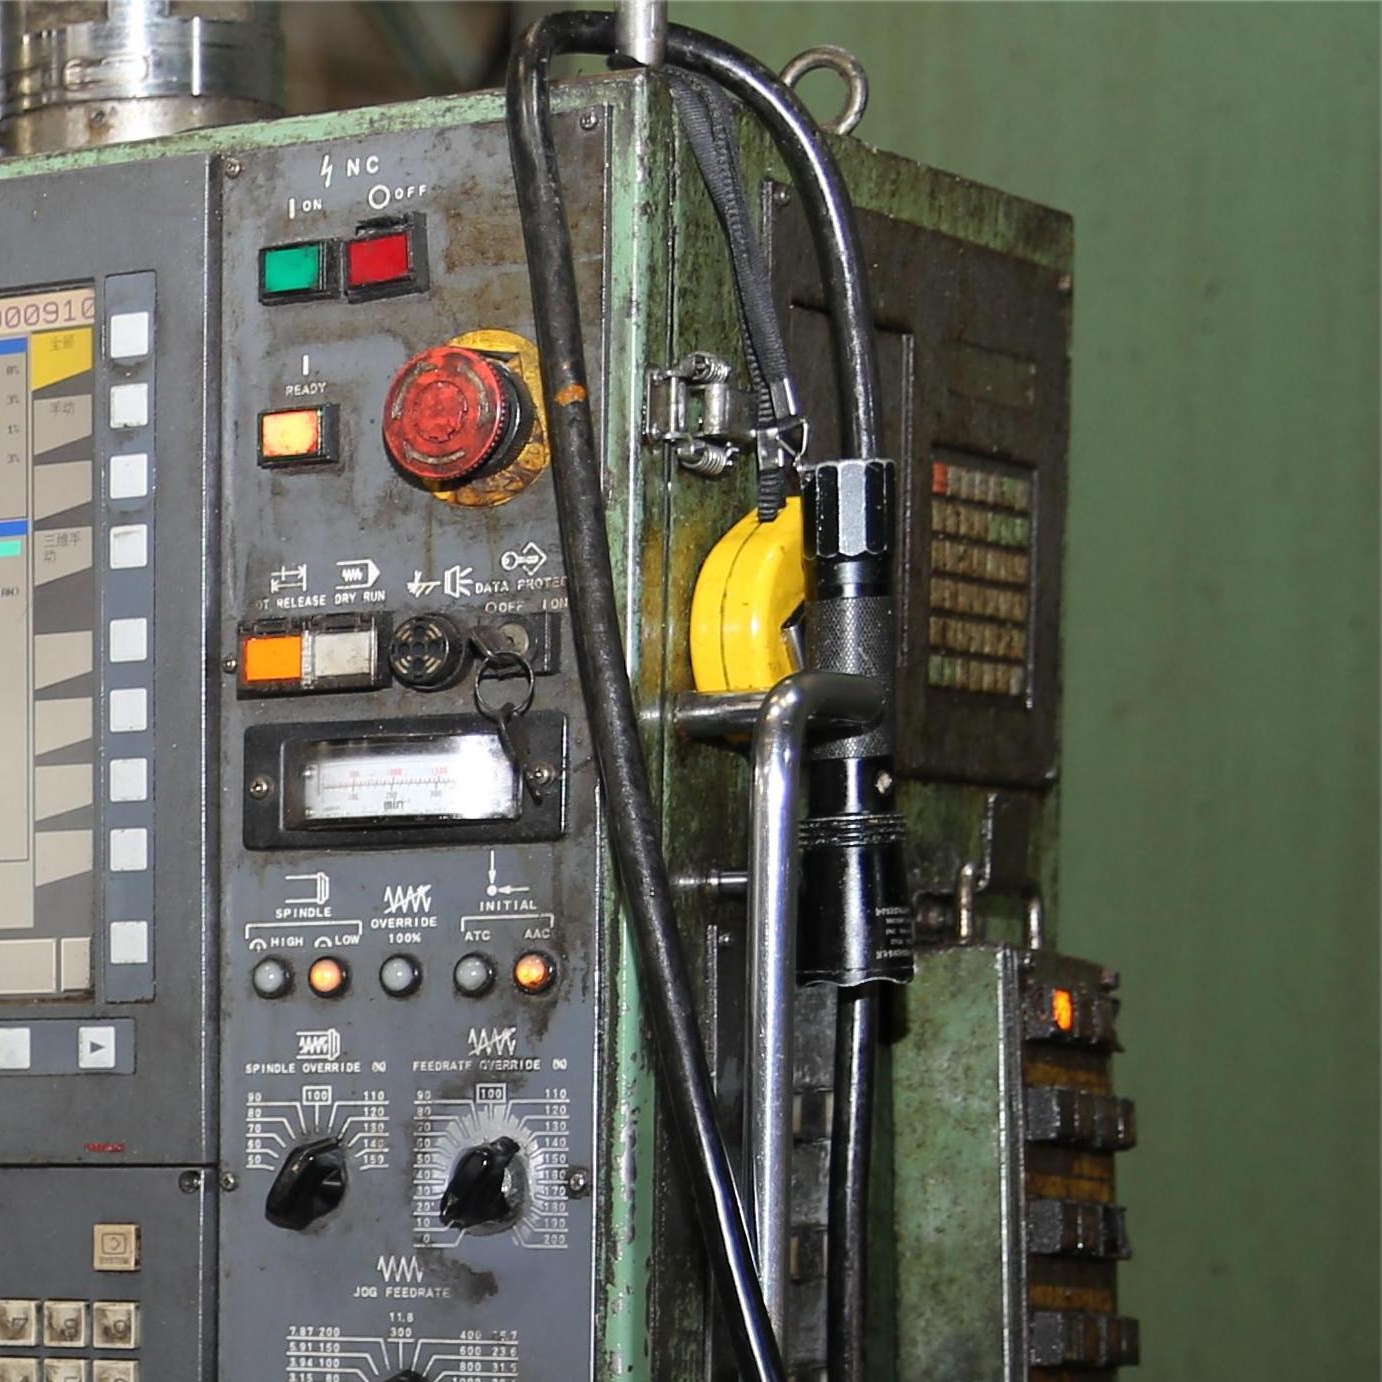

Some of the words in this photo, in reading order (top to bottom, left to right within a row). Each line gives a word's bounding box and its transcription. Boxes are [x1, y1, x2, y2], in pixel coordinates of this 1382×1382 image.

[345, 155, 380, 178] NC
[394, 184, 428, 199] OFF
[302, 199, 322, 212] ON
[285, 381, 327, 396] READY
[475, 580, 510, 594] DATA
[517, 575, 568, 591] PROTEC
[276, 594, 326, 608] RELEASE
[334, 591, 358, 605] DRY
[363, 590, 386, 603] RUN
[479, 899, 538, 912] INITIAL
[275, 907, 332, 919] SPINDLE
[370, 916, 437, 929] OVERRIDE
[335, 934, 360, 945] LOW
[388, 932, 422, 944] 100%
[464, 930, 491, 942] ATC
[524, 928, 551, 940] AAC
[270, 936, 304, 948] HIGH
[245, 1062, 296, 1074] SPINDLE
[302, 1061, 361, 1073] OVERRIDE
[307, 1091, 328, 1100] 100
[363, 1091, 384, 1100] 110
[481, 1089, 502, 1099] 100
[545, 1089, 566, 1099] 110
[363, 1107, 384, 1116] 120
[545, 1105, 566, 1115] 120
[353, 1286, 377, 1298] JOG
[386, 1286, 450, 1299] FEEDRATE
[389, 1312, 414, 1323] 11.8
[390, 1327, 412, 1337] 300
